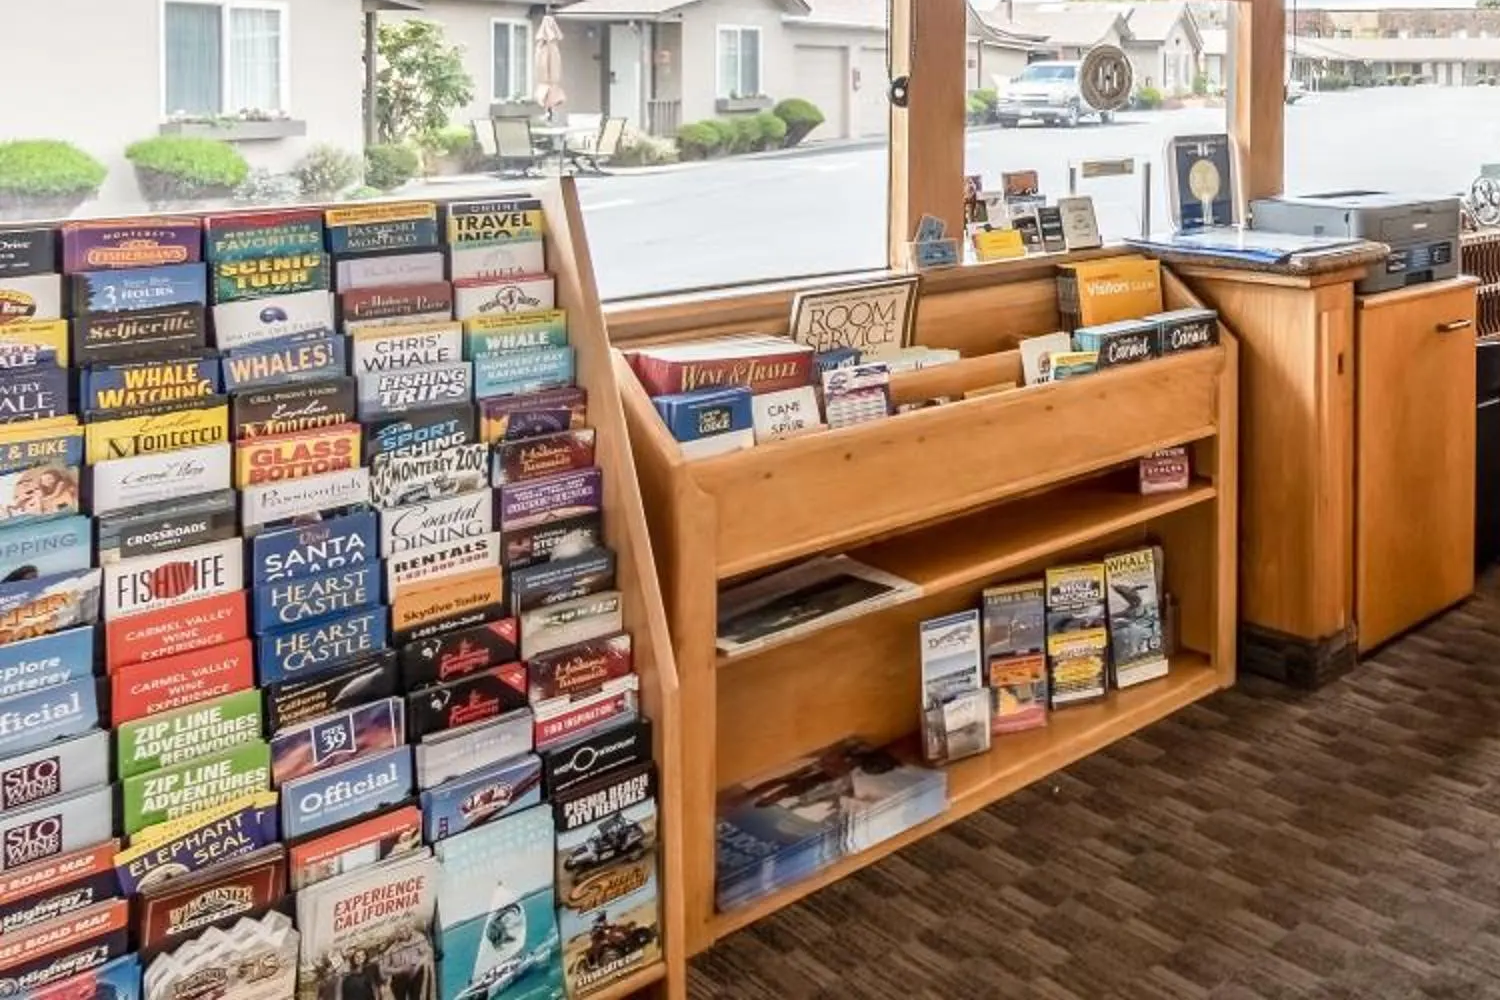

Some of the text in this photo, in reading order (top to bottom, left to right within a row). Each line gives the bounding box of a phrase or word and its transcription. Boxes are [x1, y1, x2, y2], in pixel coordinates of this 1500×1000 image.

[455, 212, 532, 230] TRAVEL
[215, 231, 320, 252] FAVORITES
[219, 253, 321, 277] SCENIC
[236, 269, 308, 289] TOUR
[103, 285, 175, 305] 3 HOURS
[1087, 281, 1130, 296] Visitors
[808, 298, 898, 334] ROOM
[375, 333, 441, 354] CHRIS'
[485, 331, 550, 350] WHALE
[804, 320, 896, 355] SERVICE
[1107, 337, 1152, 364] Carmel
[1171, 324, 1211, 350] Carmel
[0, 352, 37, 368] ALE
[229, 343, 334, 384] WHALES!
[363, 347, 449, 372] WHALE
[0, 381, 40, 395] VERY
[124, 363, 199, 389] WHALE
[379, 367, 467, 392] FISHING
[681, 365, 726, 392] WINE
[0, 391, 55, 413] ALE
[97, 378, 214, 409] WATCHING
[379, 382, 466, 407] TRIPS
[27, 439, 68, 458] BIKE
[378, 431, 466, 462] FISHING
[383, 419, 459, 450] SPORT
[250, 438, 353, 467] GLASS
[392, 446, 483, 481] MONTEREY ZOO
[249, 457, 351, 486] BOTTOM
[391, 498, 482, 537] Coastal
[0, 532, 78, 558] PPING
[126, 521, 208, 548] CROSSROADS
[391, 520, 483, 555] DINING
[264, 532, 366, 574] SANTA
[394, 540, 489, 573] RENTALS
[1105, 552, 1154, 572] WHALE
[117, 554, 226, 609] FISHWIFE
[271, 570, 369, 608] HEARST
[279, 587, 368, 623] CASTLE
[403, 591, 491, 623] Skydive Today
[124, 607, 234, 642] CARMEL VALLEY
[162, 627, 200, 645] WINE
[275, 615, 375, 657] HEARST
[140, 632, 226, 661] EXPERIENCE
[283, 633, 372, 671] CASTLE
[0, 655, 62, 685] plore
[0, 668, 73, 697] nterey
[130, 657, 241, 696] CARMEL VALLEY
[146, 683, 231, 714] EXPERIENCE
[168, 679, 205, 697] WINE
[0, 692, 81, 735] ficial
[133, 706, 223, 746] ZIP LINE
[133, 712, 258, 761] ADVENTURES
[159, 727, 259, 768] REDWOODS
[321, 728, 347, 754] 39
[5, 759, 58, 787] SLO
[6, 774, 58, 800] WINE
[143, 759, 233, 798] ZIP LINE
[300, 763, 398, 813] Official
[141, 767, 267, 815] ADVENTURES
[564, 773, 649, 818] PISMO BEACH
[567, 788, 647, 829] ATV RENTALS
[7, 817, 60, 846] SLO
[8, 833, 60, 859] WINE
[129, 814, 244, 878] ELEPHANT
[193, 832, 251, 867] SEAL
[9, 855, 95, 891] ROAD MAP
[3, 892, 82, 928] Highway
[333, 875, 426, 917] EXPERIENCE
[334, 892, 420, 933] CALIFORNIA
[25, 927, 73, 950] ROAD
[75, 912, 111, 932] MAP
[19, 949, 98, 987] Highway
